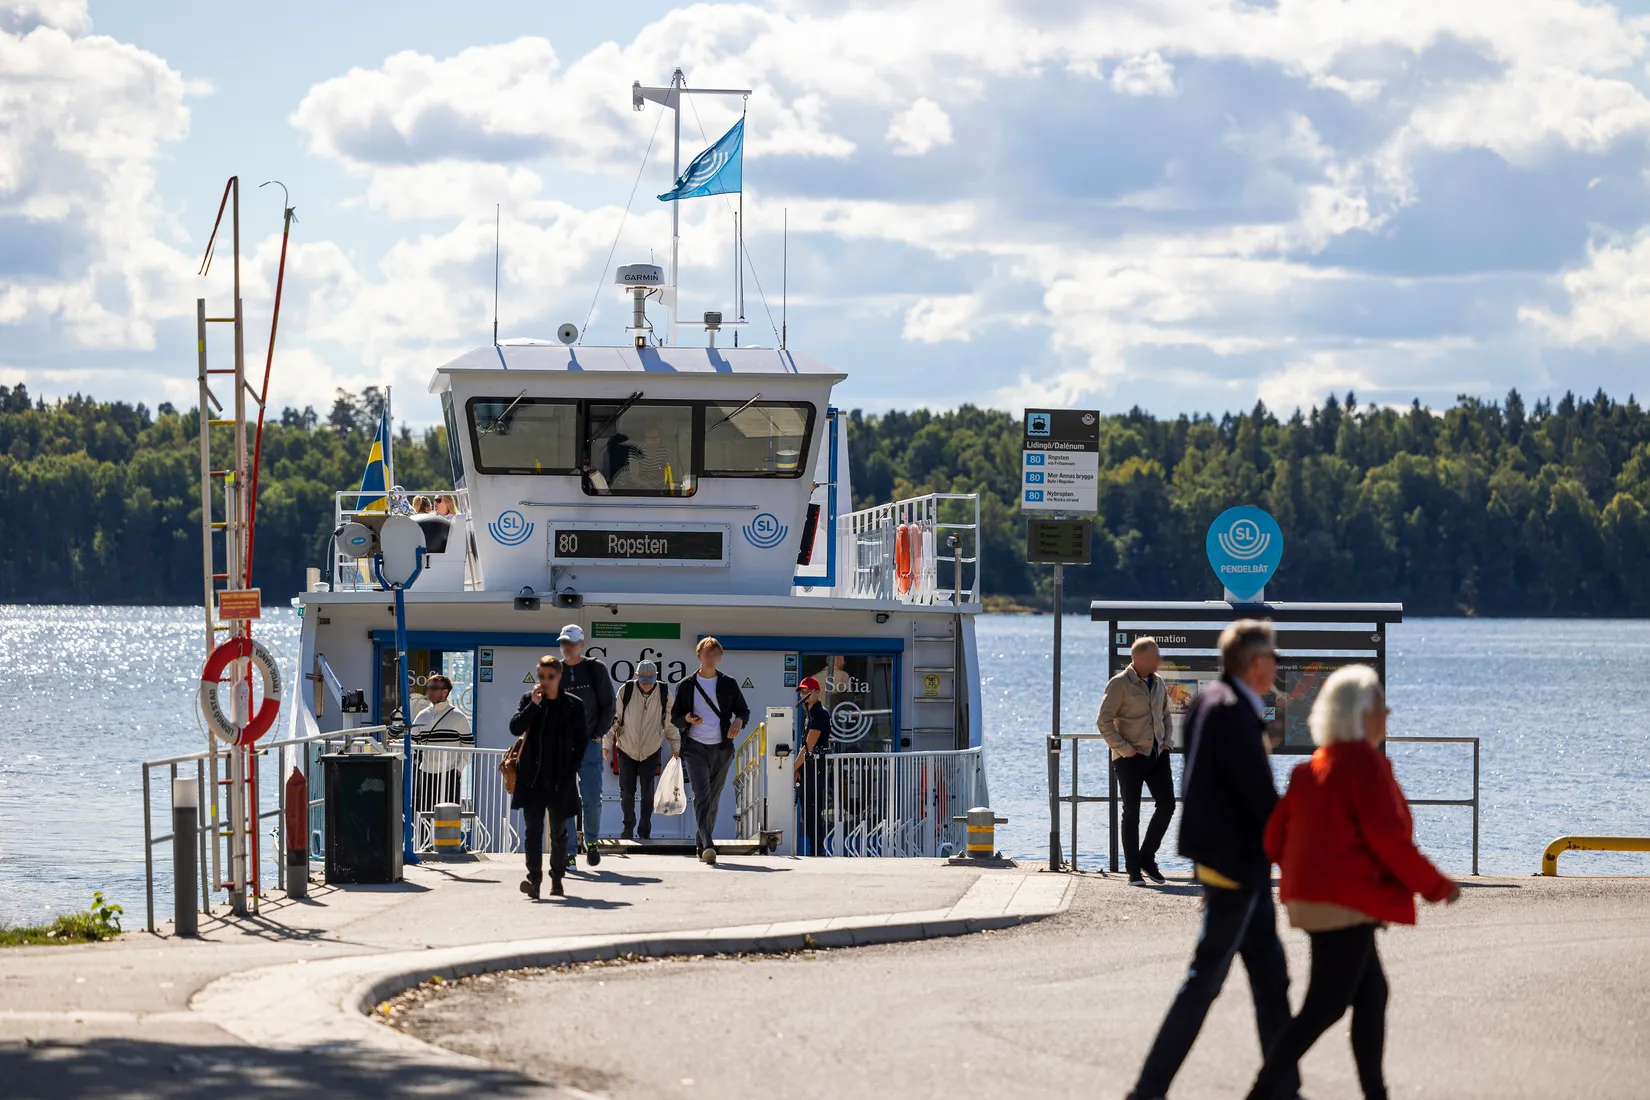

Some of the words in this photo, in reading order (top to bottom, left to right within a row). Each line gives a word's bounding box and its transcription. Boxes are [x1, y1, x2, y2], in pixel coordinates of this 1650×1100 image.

[1026, 441, 1085, 450] Lidingö/Dalénum
[1030, 455, 1041, 464] 80
[1029, 473, 1040, 482] 80
[1029, 491, 1040, 500] 80
[503, 517, 520, 529] SL
[757, 520, 774, 532] SL
[1235, 527, 1254, 541] SL
[559, 534, 578, 553] 80
[608, 534, 668, 557] Ropsten
[1220, 563, 1269, 574] PENDELBÅT
[1134, 633, 1187, 643] Imation
[585, 646, 688, 684] oia
[824, 676, 871, 693] Sofia
[209, 689, 218, 711] STAD
[837, 710, 857, 723] SL
